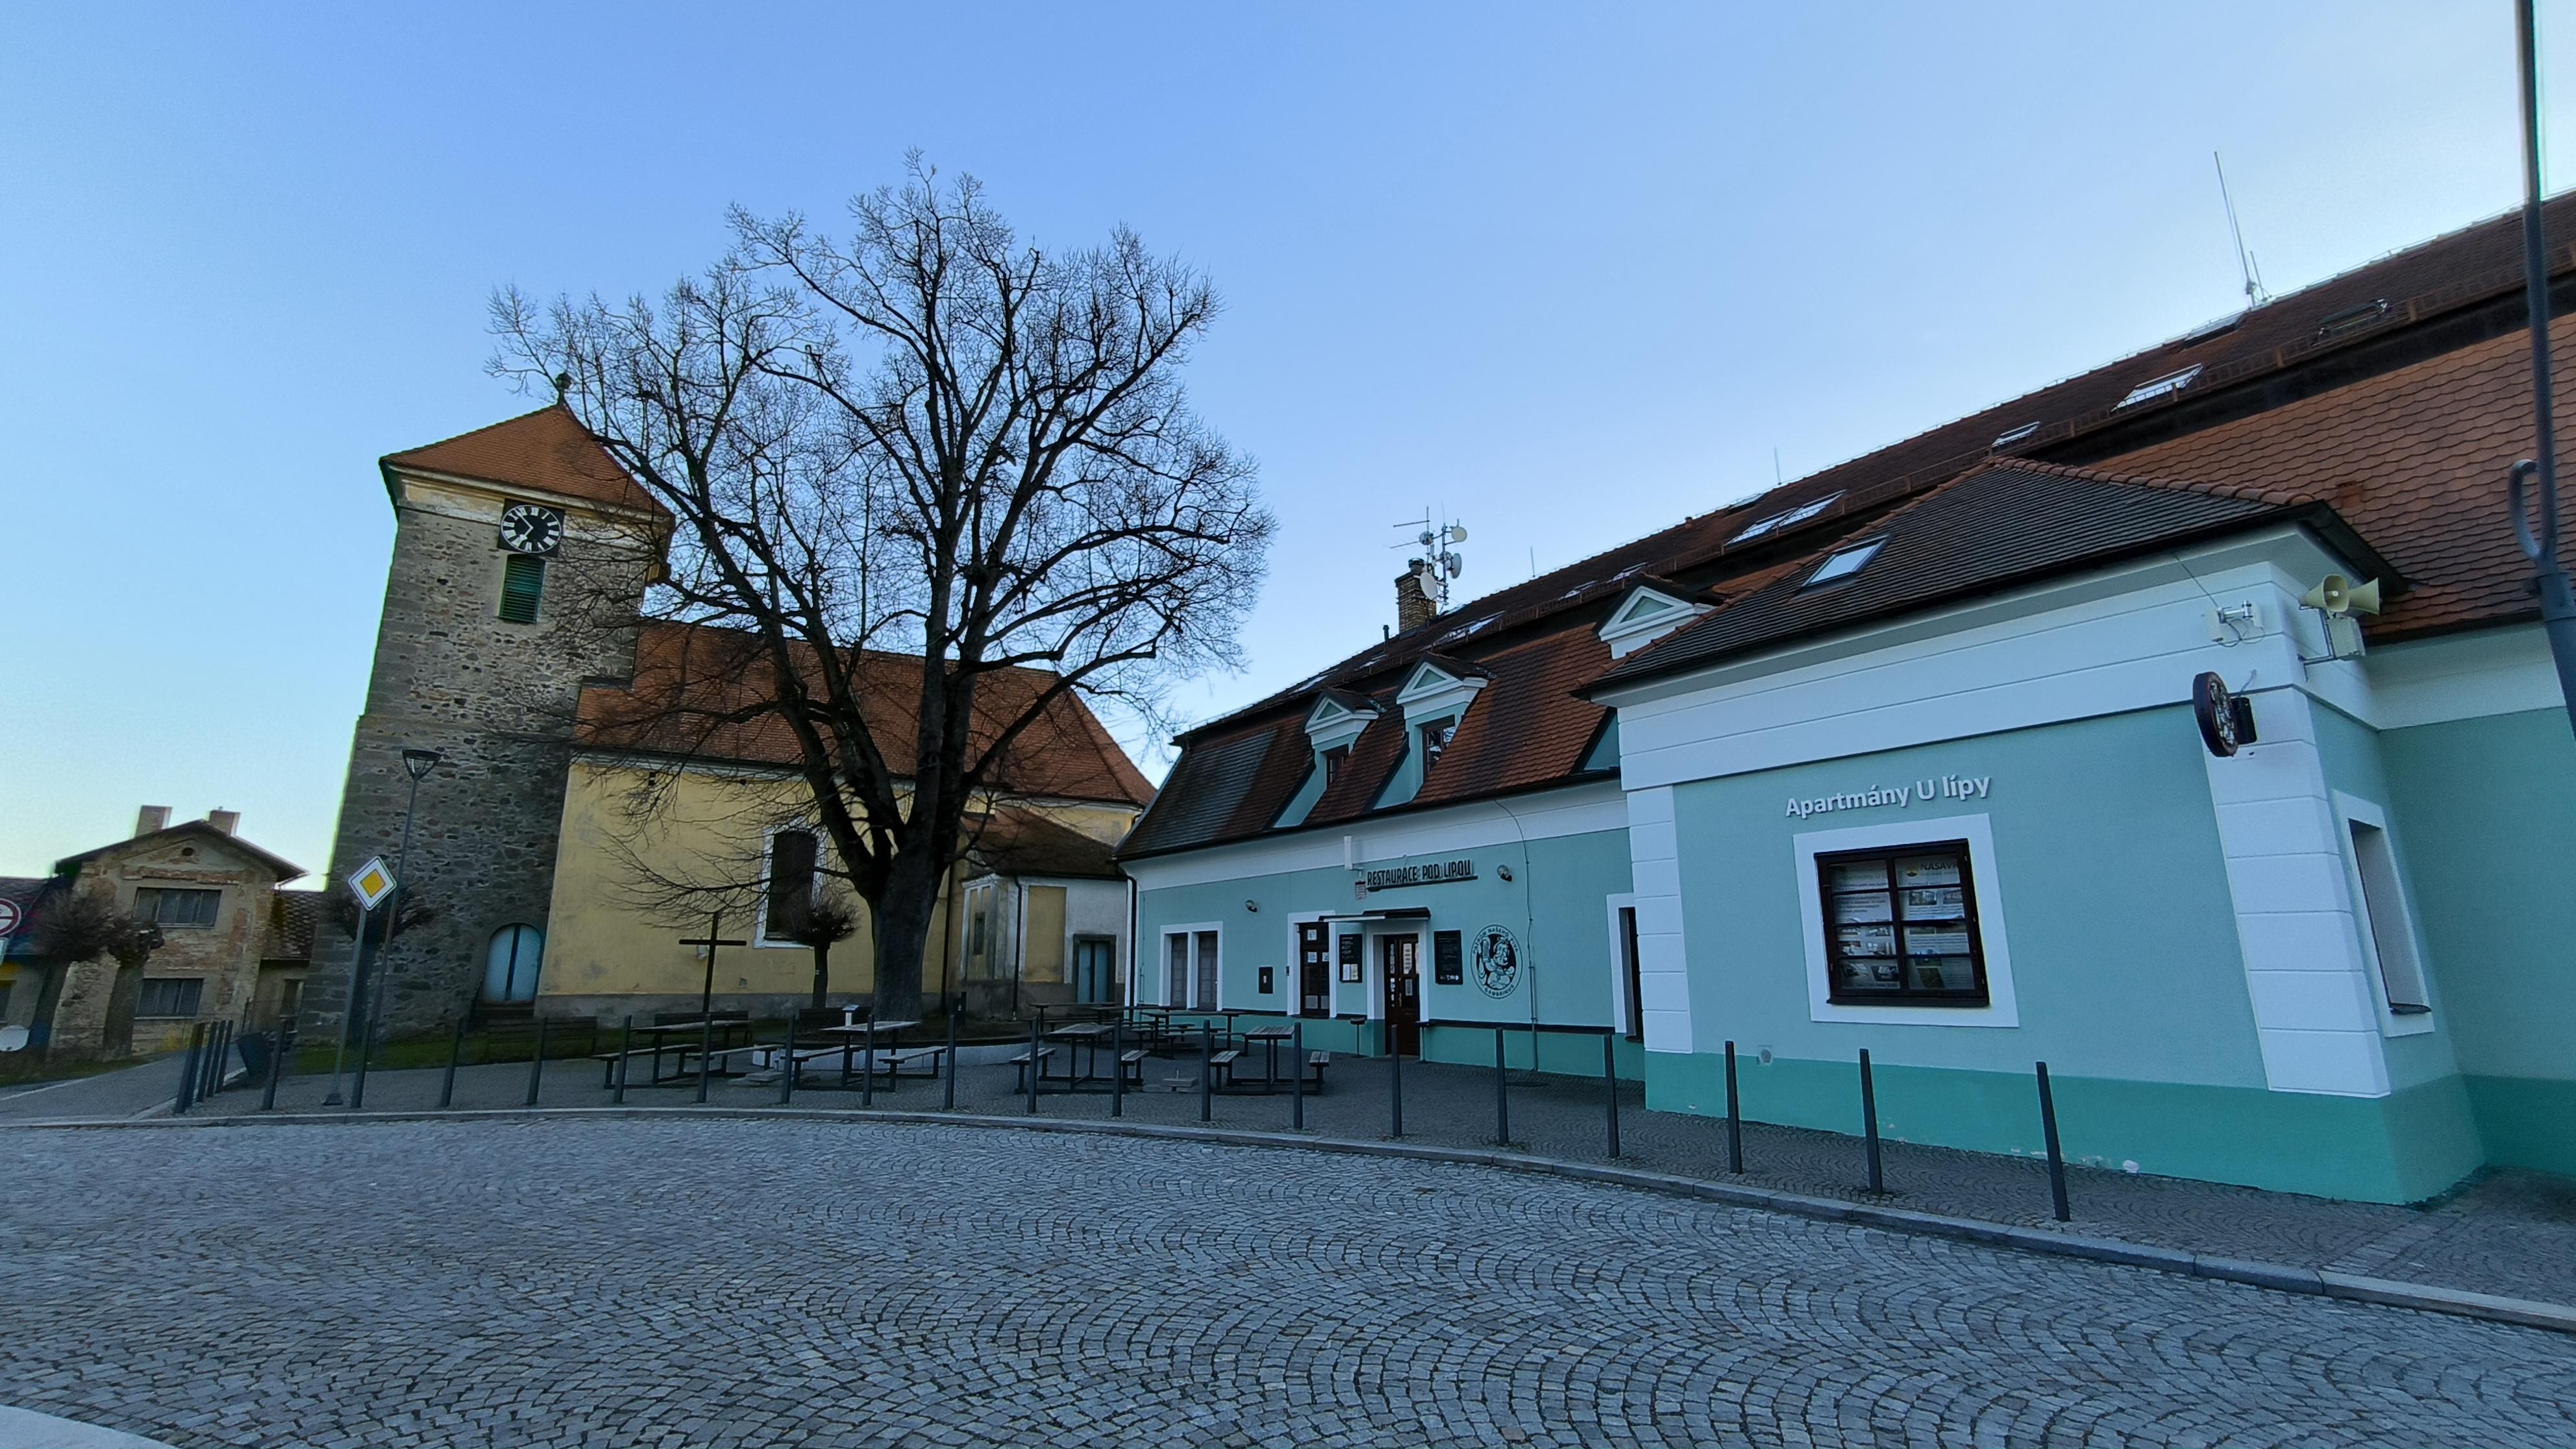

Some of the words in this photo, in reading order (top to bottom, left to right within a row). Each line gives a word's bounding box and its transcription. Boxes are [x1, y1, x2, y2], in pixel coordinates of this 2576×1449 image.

[1785, 784, 1911, 819] Apartmány
[1916, 779, 1935, 800] U
[1942, 774, 1990, 801] lípy
[1367, 866, 1418, 886] RESTAURACE
[1422, 863, 1441, 880] POD
[1444, 860, 1472, 877] LIPOU
[1510, 937, 1518, 953] PIVA
[1484, 984, 1515, 997] GAMBRINUS
